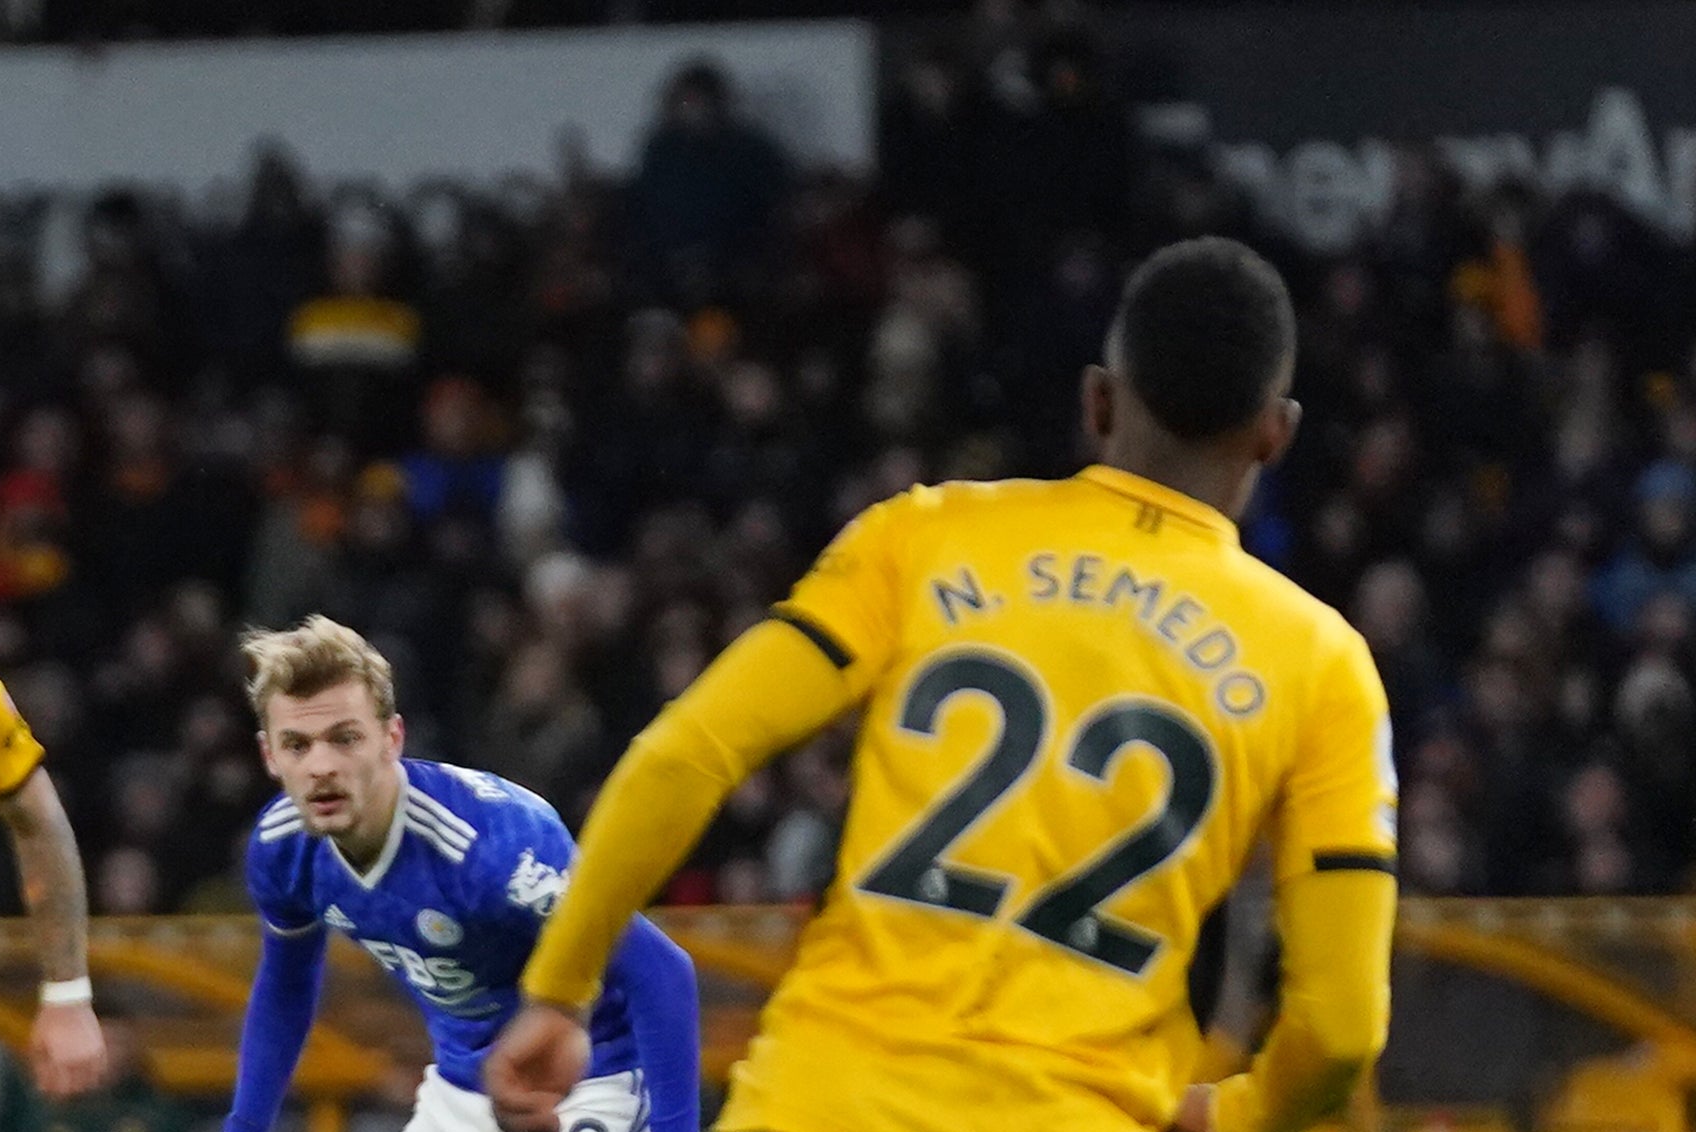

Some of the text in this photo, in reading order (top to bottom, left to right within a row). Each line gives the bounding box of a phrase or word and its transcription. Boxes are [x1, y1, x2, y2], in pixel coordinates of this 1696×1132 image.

[931, 552, 1266, 717] N. SEMEDO
[854, 650, 1220, 976] 22
[360, 938, 476, 990] FBS
